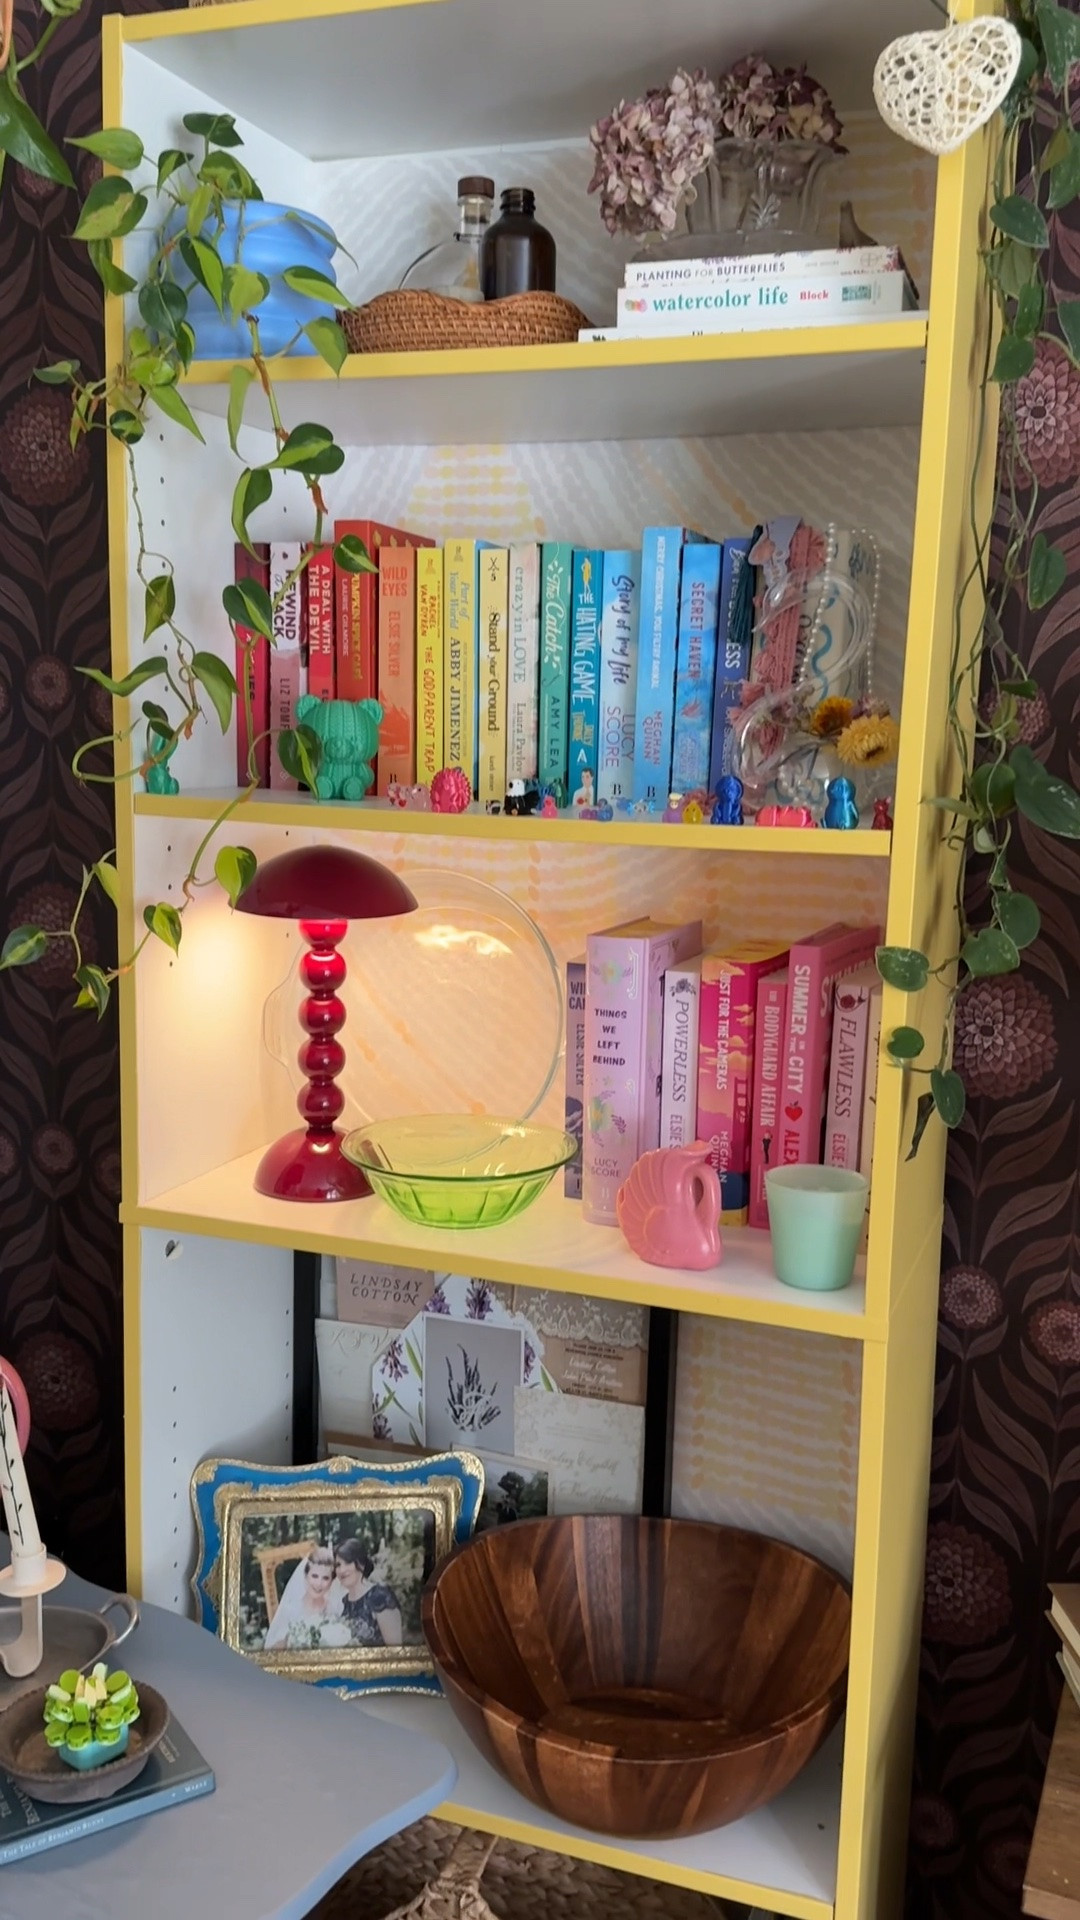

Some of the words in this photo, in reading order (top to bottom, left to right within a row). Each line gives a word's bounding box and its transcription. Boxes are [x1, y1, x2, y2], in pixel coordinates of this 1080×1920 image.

[635, 268, 691, 282] PLANTING
[694, 267, 714, 279] FOR
[717, 261, 786, 277] BUTTERFLIES
[652, 289, 752, 312] watercolor
[758, 284, 789, 306] life
[800, 290, 829, 301] Block
[309, 565, 319, 597] THE
[321, 565, 330, 575] A
[382, 566, 408, 581] WILD
[448, 571, 460, 596] Your
[321, 580, 331, 615] DEAL
[382, 583, 408, 597] EYES
[420, 584, 428, 605] VAN
[459, 581, 470, 605] Part
[512, 566, 526, 614] crazy
[545, 573, 562, 600] The
[579, 593, 594, 604] THE
[611, 575, 635, 614] Story
[285, 569, 297, 641] REWIND
[429, 595, 437, 629] RACHEL
[449, 600, 460, 630] World
[690, 582, 705, 631] SECRET
[309, 604, 319, 655] DEVIL
[321, 619, 331, 655] WITH
[388, 610, 401, 639] ELSIE
[488, 611, 501, 652] Stand
[514, 618, 529, 633] in
[544, 600, 565, 654] Catch
[575, 607, 597, 658] HATING
[616, 618, 631, 632] of
[387, 641, 401, 677] SILVER
[424, 646, 433, 664] THE
[450, 637, 461, 680] ABBY
[513, 637, 527, 683] LOVE
[611, 636, 629, 657] my
[687, 636, 702, 679] HAVEN
[279, 677, 290, 696] LIZ
[572, 660, 596, 706] GAME
[606, 660, 631, 685] Life
[279, 698, 290, 730] TOMF
[423, 668, 436, 738] GODPARENT
[487, 679, 500, 732] Ground
[516, 703, 527, 734] Laura
[549, 696, 561, 731] AMY
[449, 686, 462, 762] JIMENEZ
[605, 706, 621, 768] SCORE
[622, 714, 636, 762] LUCY
[643, 716, 654, 760] QUINN
[650, 710, 663, 766] MEGHAN
[423, 743, 436, 773] TRAP
[515, 738, 527, 773] Pavlov
[549, 738, 560, 768] LEA
[719, 969, 731, 996] JUST
[594, 1008, 628, 1019] THINGS
[718, 997, 731, 1018] FOR
[790, 964, 811, 1036] SUMMER
[602, 1026, 617, 1035] WE
[717, 1018, 730, 1039] THE
[761, 1005, 780, 1081] BODYGUARD
[592, 1055, 626, 1067] BEHIND
[597, 1040, 621, 1051] LEFT
[672, 999, 690, 1103] POWERLESS
[716, 1040, 730, 1091] CAMERAS
[787, 1056, 805, 1095] CITY
[834, 1016, 857, 1119] FLAWLESS
[759, 1083, 777, 1128] AFFAIR
[669, 1113, 683, 1143] ELSIE
[594, 1157, 618, 1169] LUCY
[719, 1130, 729, 1184] MEGHAN
[831, 1132, 846, 1163] ELSIE
[590, 1165, 622, 1178] SCORE
[350, 1273, 423, 1292] LINDSAY
[352, 1286, 419, 1306] COTTON
